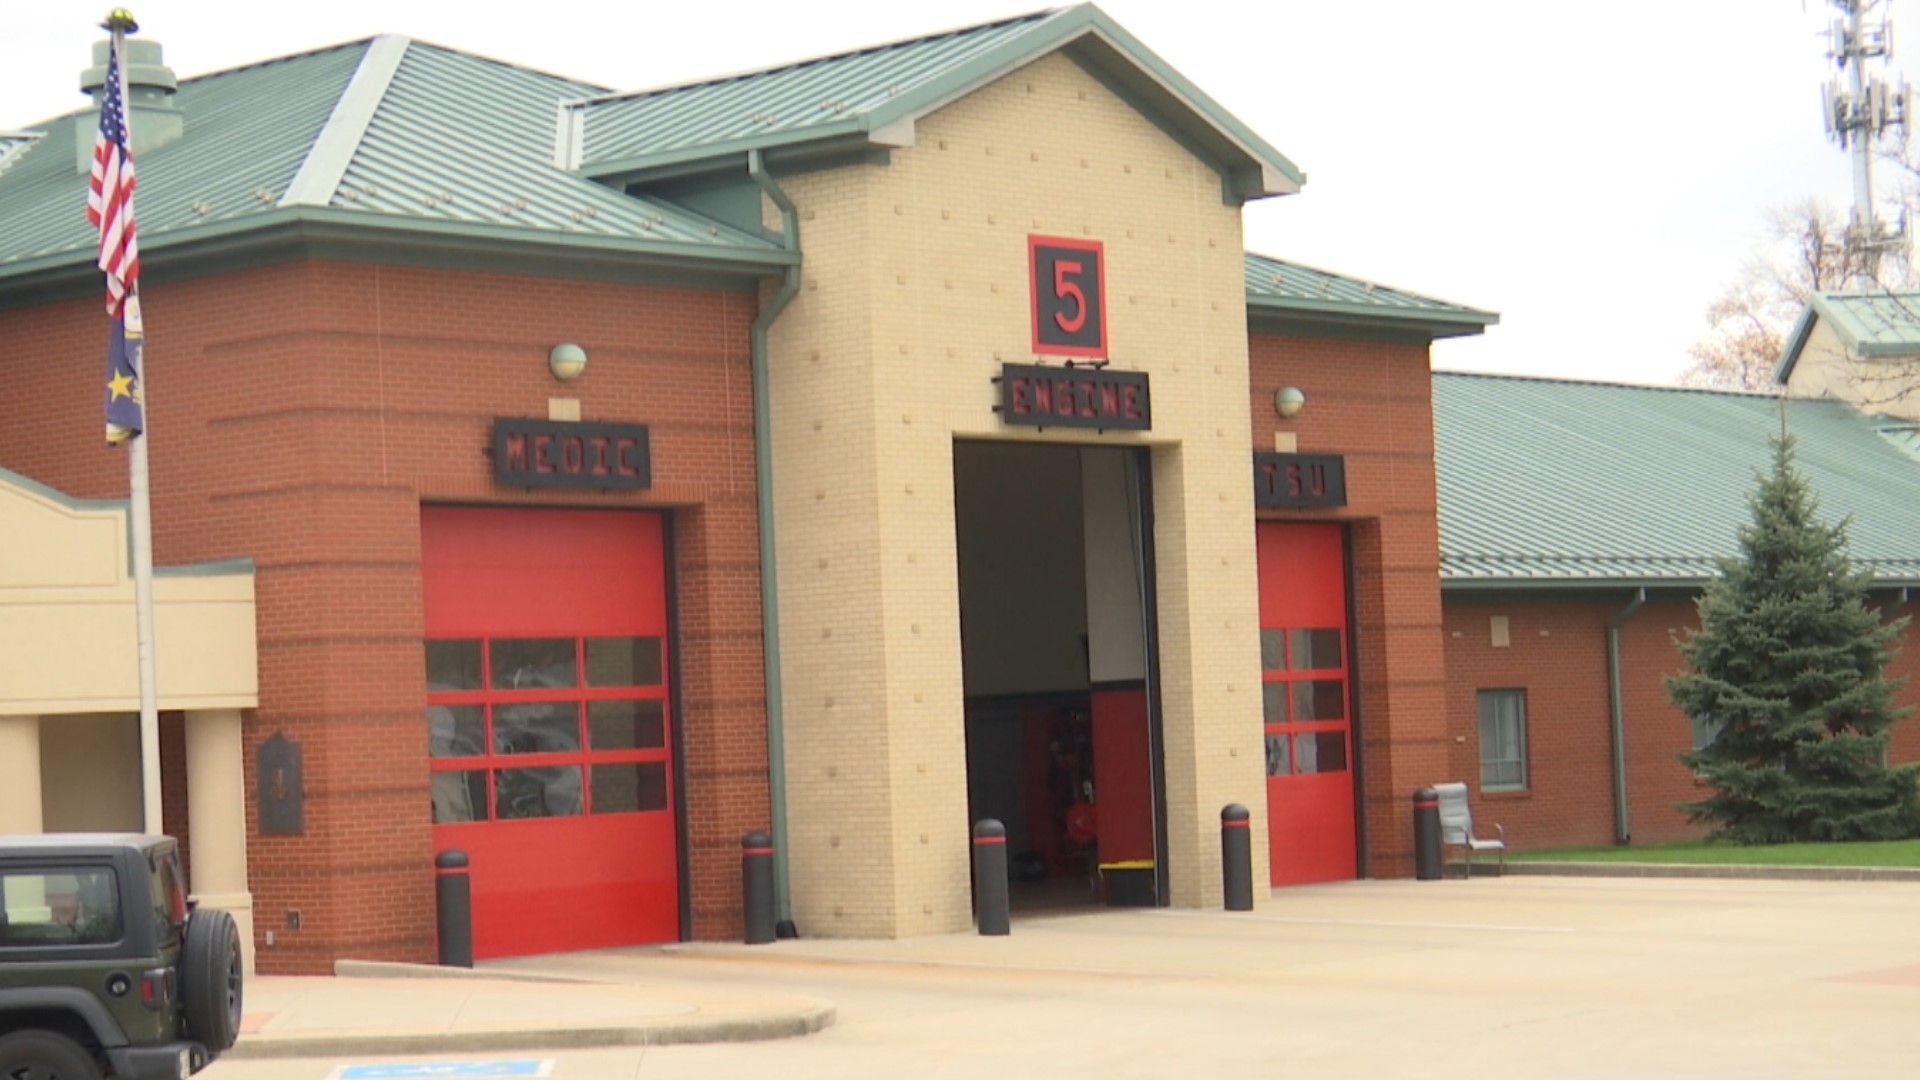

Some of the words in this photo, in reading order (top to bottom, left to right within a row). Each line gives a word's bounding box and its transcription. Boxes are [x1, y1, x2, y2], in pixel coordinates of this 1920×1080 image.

[1054, 260, 1087, 333] 5
[1011, 377, 1142, 420] ENGINE
[506, 432, 639, 476] MEDIC
[1262, 463, 1326, 496] TSU
